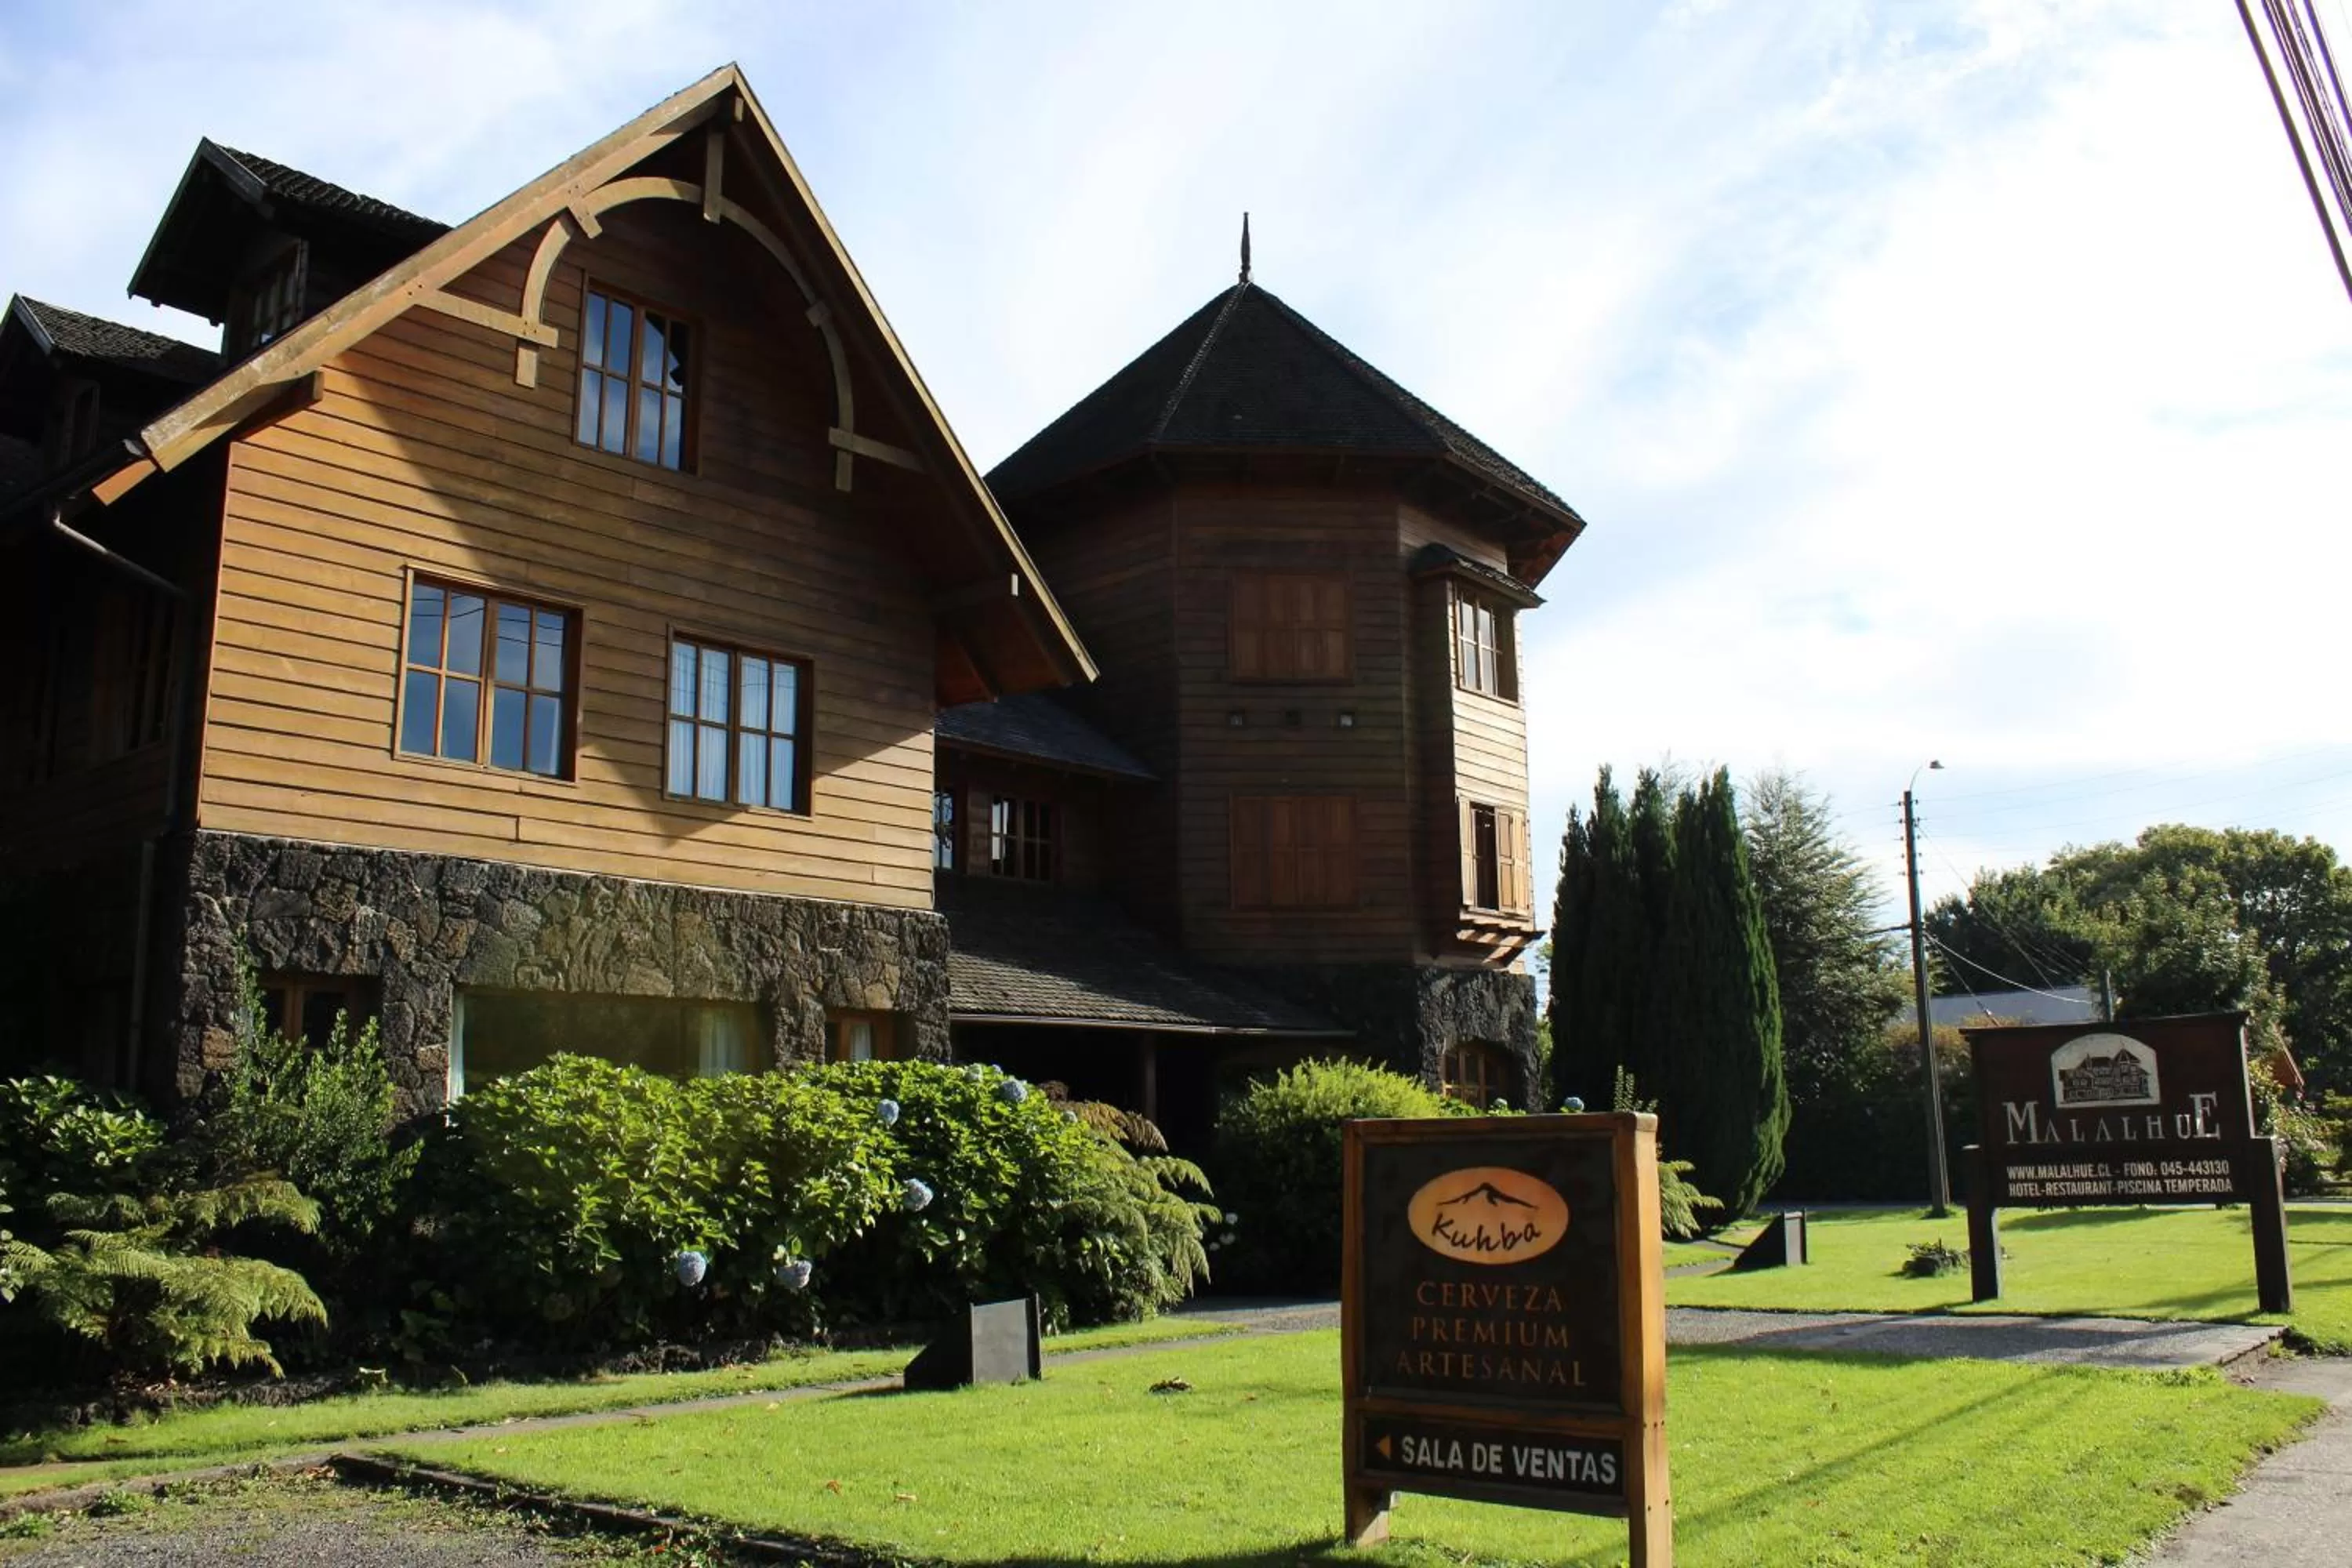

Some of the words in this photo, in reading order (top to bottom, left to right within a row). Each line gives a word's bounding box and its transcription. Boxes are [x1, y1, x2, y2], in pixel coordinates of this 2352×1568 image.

[2002, 1091, 2221, 1145] MALALHUE
[2006, 1163, 2112, 1180] WWW.MALALHUE.CL
[2160, 1160, 2230, 1177] 045-443130
[2164, 1178, 2234, 1193] TEMPERADA
[1416, 1280, 1563, 1312] CERVEZA
[1412, 1316, 1570, 1349] PREMIUM
[1396, 1349, 1588, 1387] ARTESANAL
[1401, 1436, 1465, 1470] SALA
[1472, 1442, 1504, 1475] DE
[1512, 1445, 1617, 1485] VENTAS
